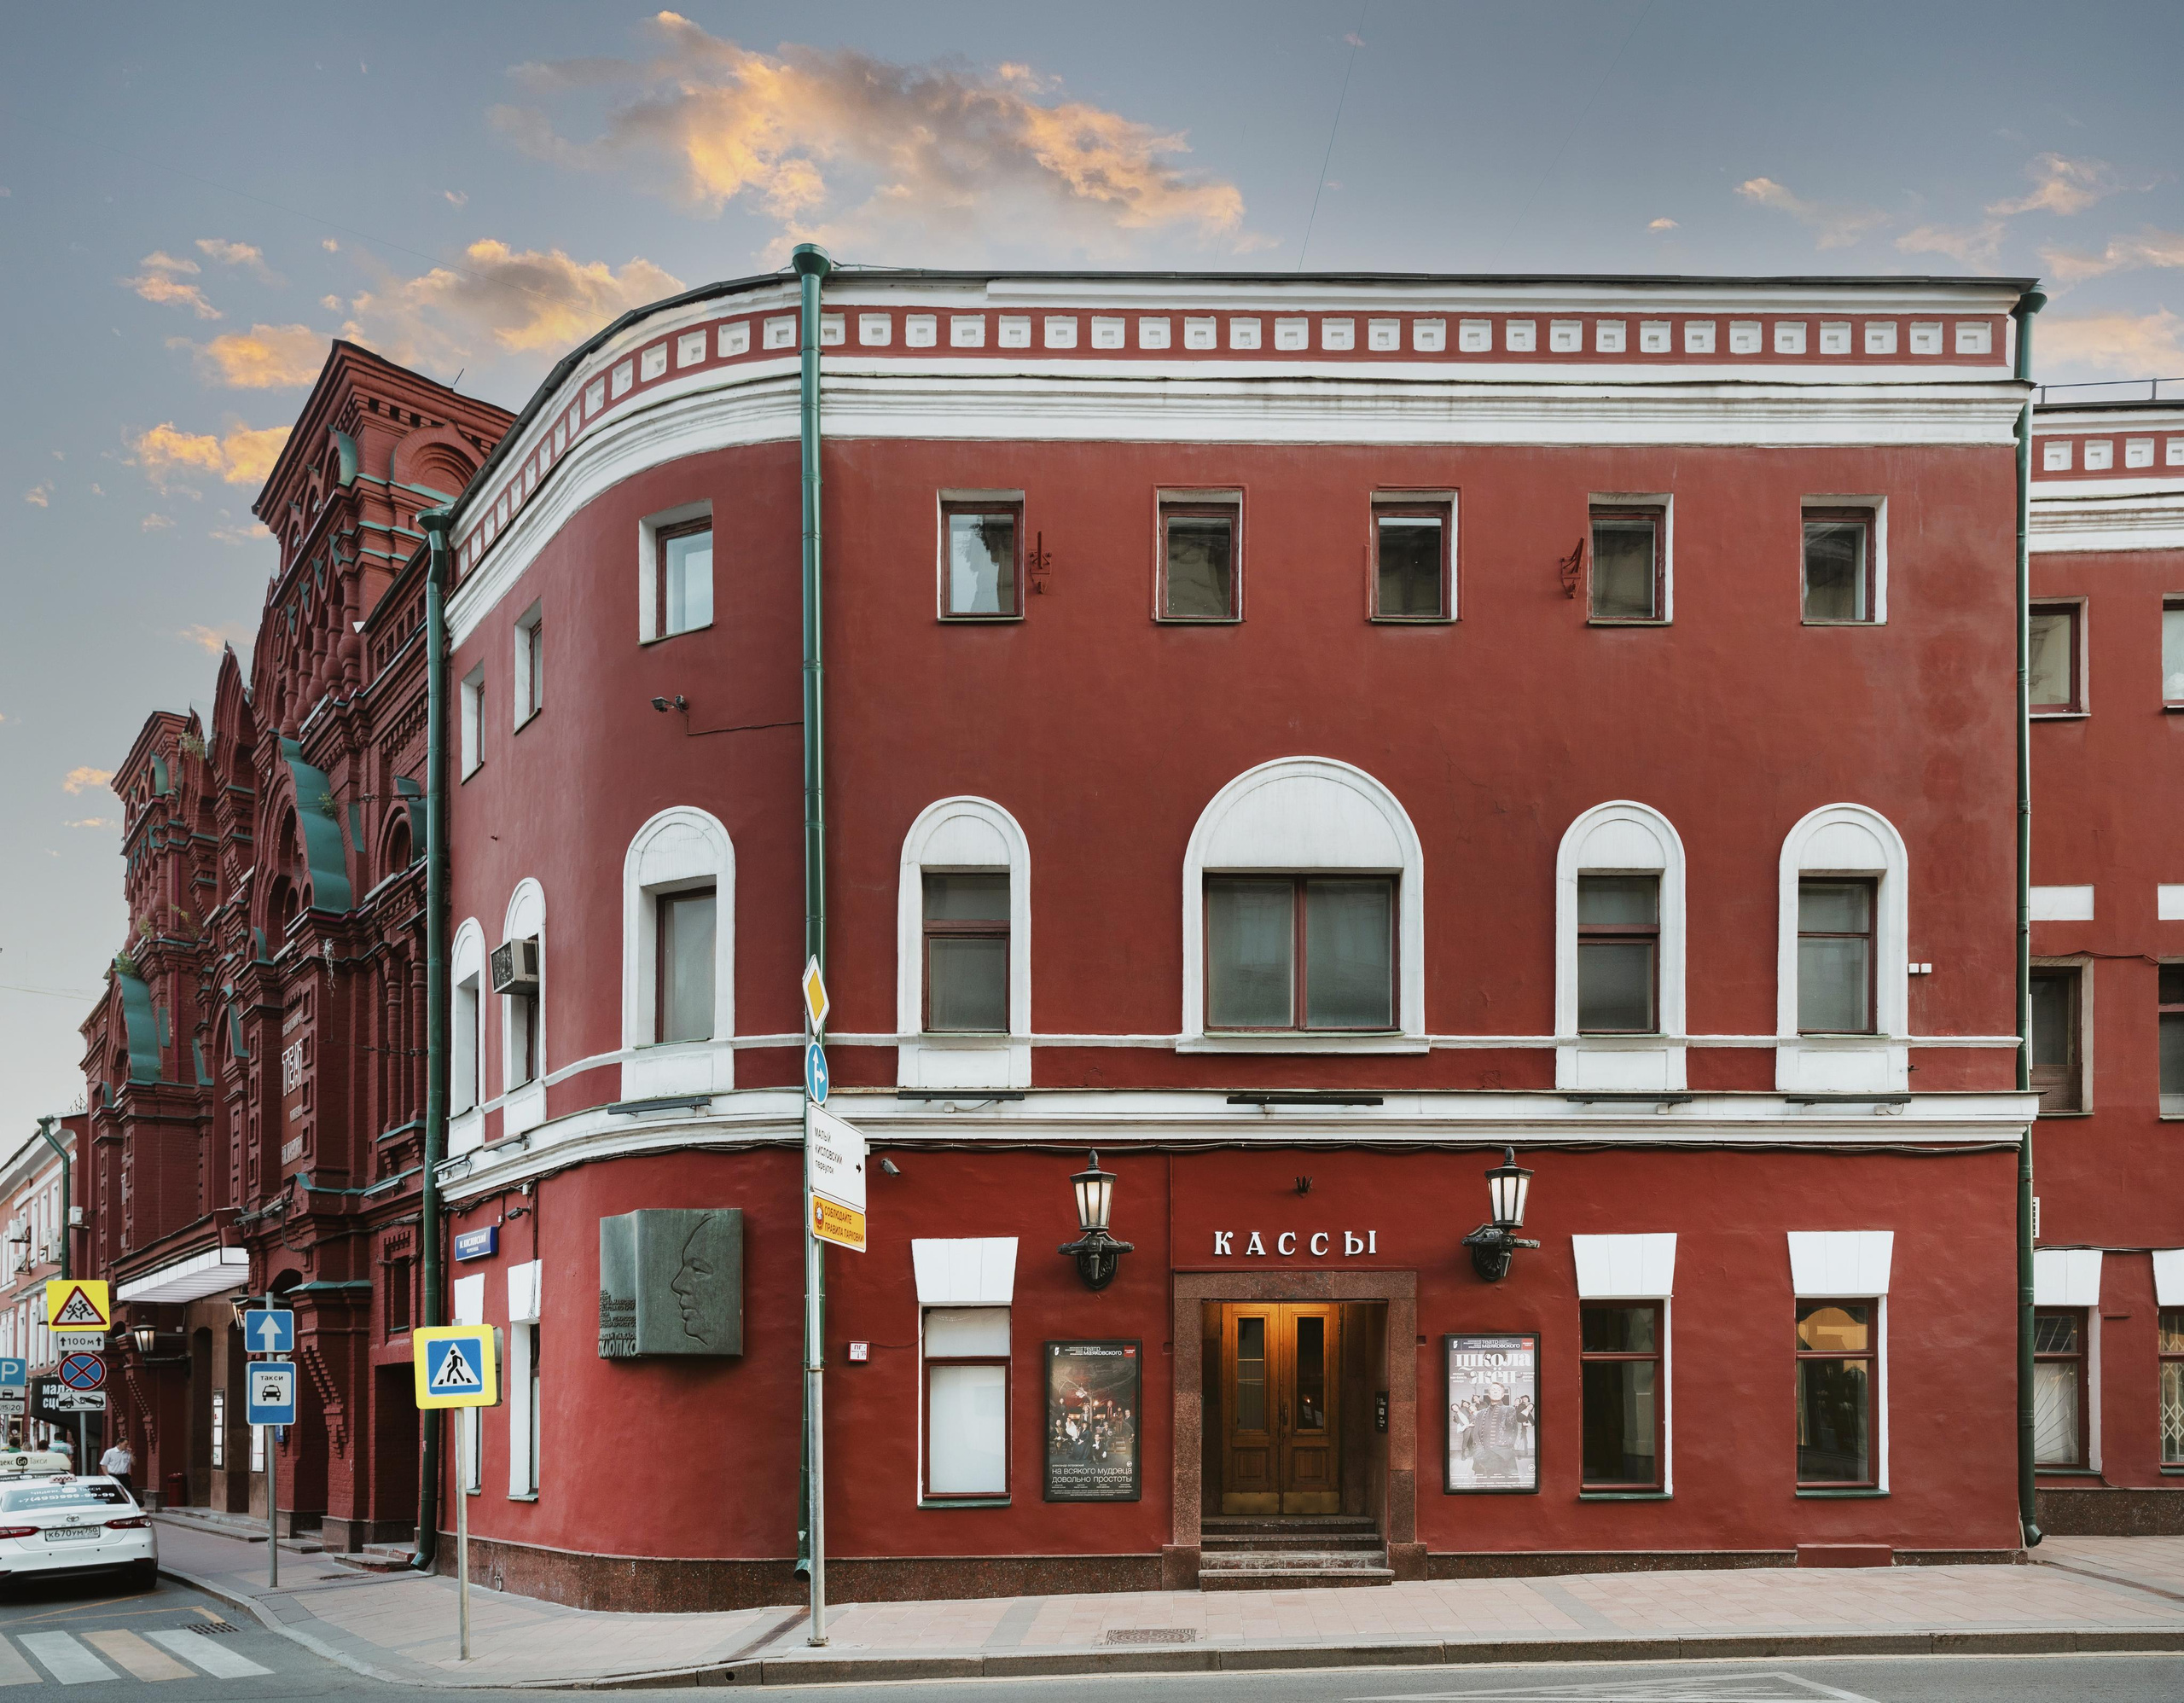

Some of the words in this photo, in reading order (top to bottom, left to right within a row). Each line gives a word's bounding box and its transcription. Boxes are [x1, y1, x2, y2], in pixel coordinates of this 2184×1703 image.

[825, 1206, 851, 1223] СОБЛЮДАЙТЕ
[825, 1223, 844, 1236] ПРАВИЛА
[1214, 1230, 1377, 1257] КАССЫ
[1097, 1468, 1133, 1476] мудреца
